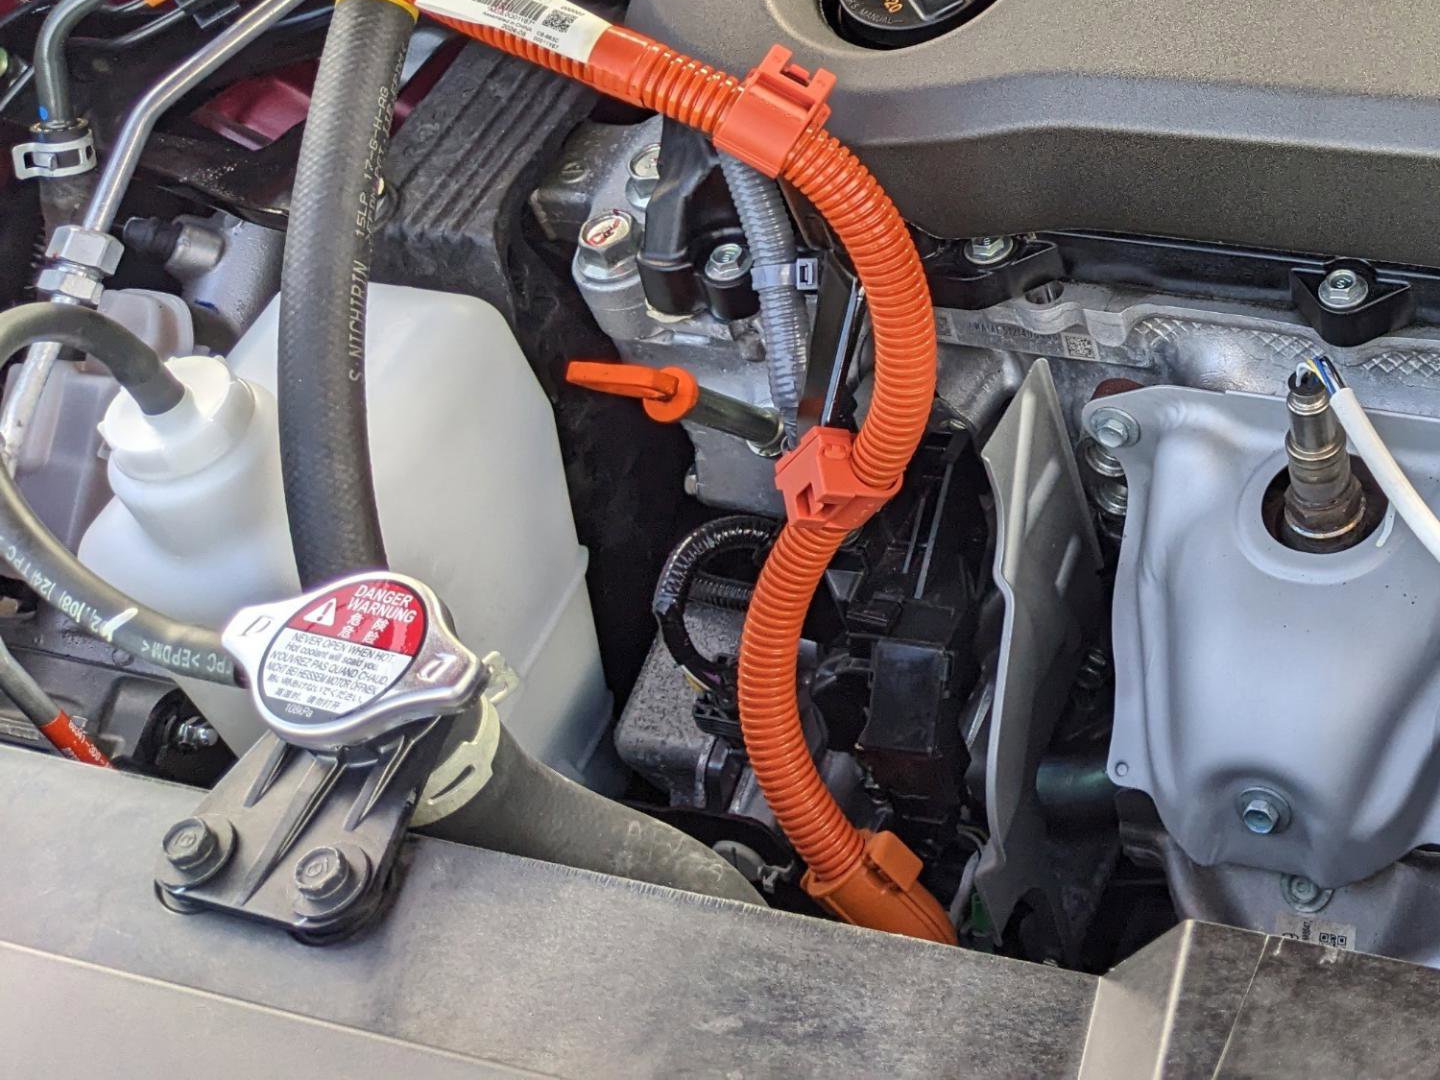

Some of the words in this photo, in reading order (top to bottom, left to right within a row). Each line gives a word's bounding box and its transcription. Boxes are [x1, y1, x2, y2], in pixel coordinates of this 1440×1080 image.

[860, 8, 894, 25] MANUAL
[355, 191, 369, 238] 15LP
[354, 584, 413, 608] DANGER
[347, 597, 418, 623] WARNUNG
[285, 641, 299, 653] Hot
[292, 632, 324, 646] NEVER
[322, 639, 347, 652] OPEN
[347, 644, 376, 659] WHEN
[311, 659, 329, 671] PAS
[328, 663, 359, 678] QUAND
[326, 674, 353, 688] MOTOR
